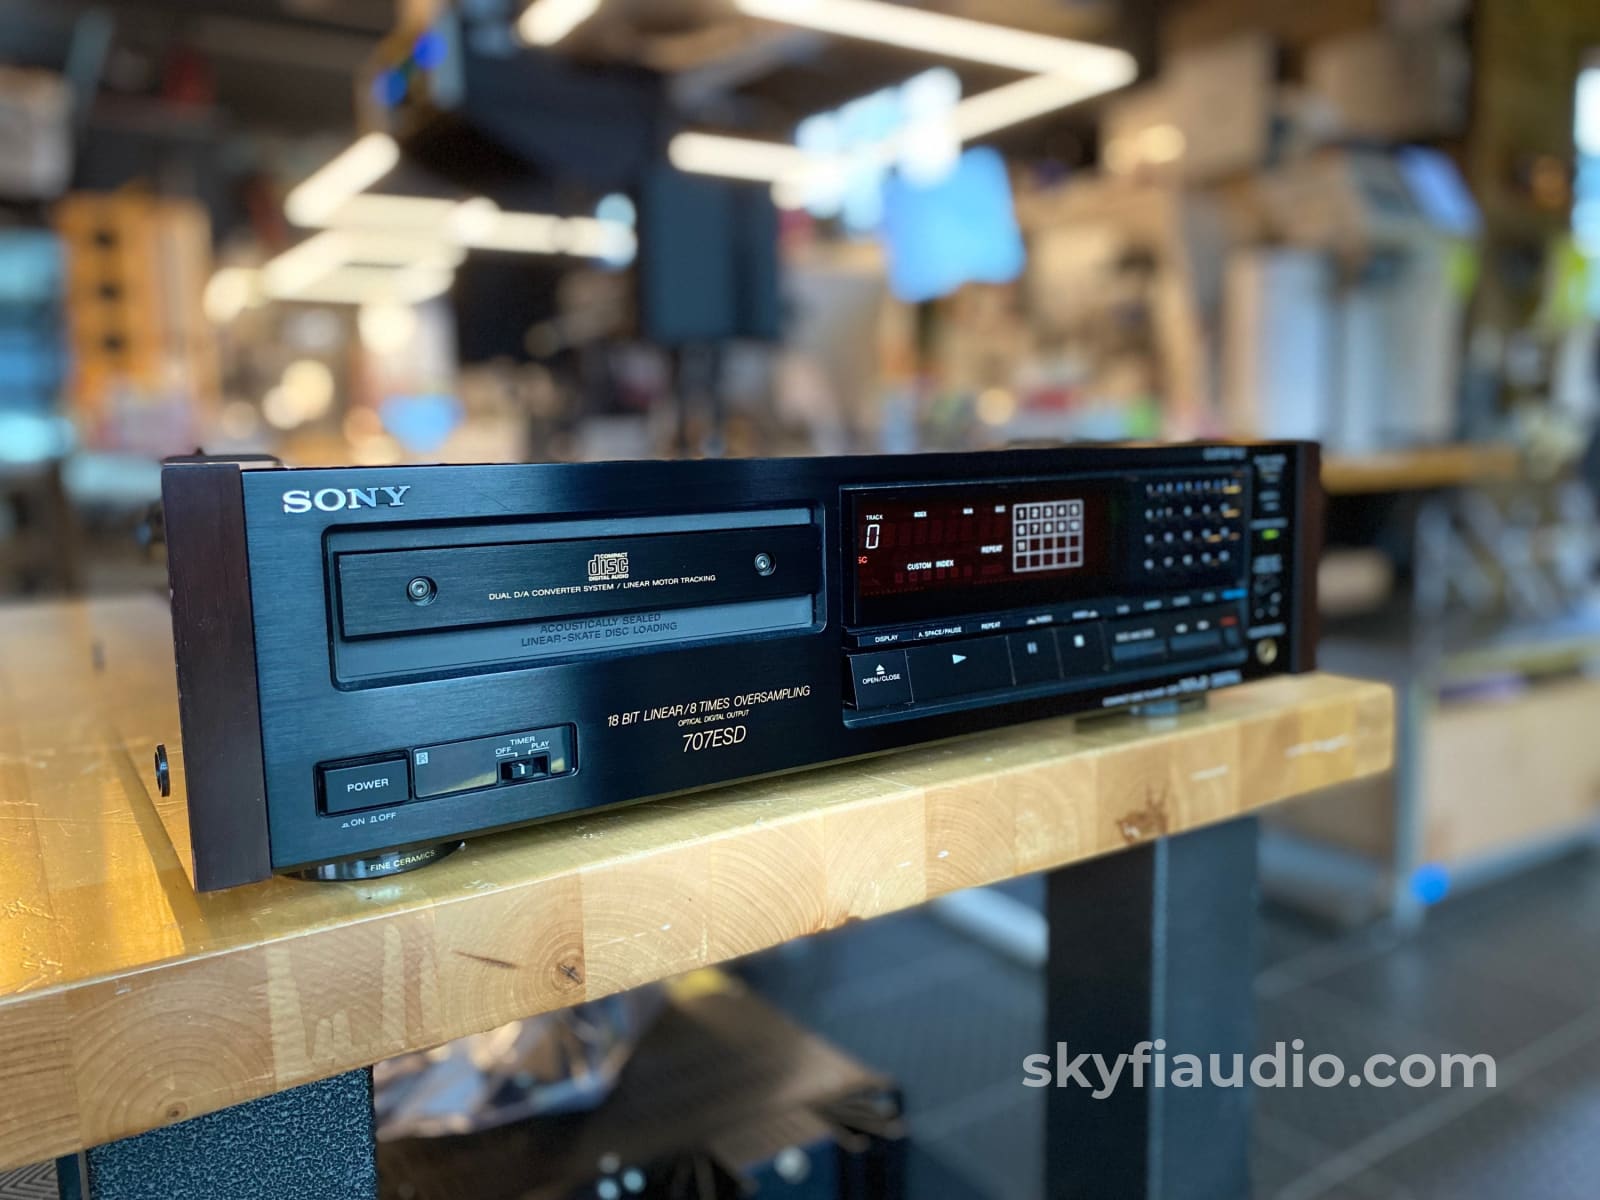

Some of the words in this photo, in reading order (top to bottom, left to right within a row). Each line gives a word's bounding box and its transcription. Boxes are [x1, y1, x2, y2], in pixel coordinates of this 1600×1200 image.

[282, 485, 411, 514] SONY
[981, 544, 1003, 554] REPEAT
[588, 554, 629, 576] disc
[907, 561, 932, 571] CUSTOM
[935, 559, 954, 568] INDEX
[488, 591, 512, 601] DUAL
[513, 589, 530, 598] D/A
[531, 586, 581, 598] CONVERTER
[583, 583, 614, 593] SYSTEM
[623, 580, 650, 589] LINEAR
[652, 577, 679, 586] MOTOR
[680, 574, 716, 584] TRACKING
[540, 617, 619, 634] ACOUSTICALLY
[622, 613, 661, 624] SEALED
[981, 621, 1001, 630] REPEAT
[521, 629, 601, 647] LINEAR-SKATE
[605, 626, 630, 638] DISC
[633, 622, 678, 635] LOADING
[874, 634, 899, 643] DISPLAY
[862, 673, 901, 685] OPEN/CLOSE
[607, 714, 619, 728] 18
[621, 710, 640, 726] BIT
[699, 697, 730, 713] TIMES
[734, 685, 811, 707] OVERSAMPLING
[678, 717, 702, 727] OPTICAL
[703, 713, 725, 723] DIGITAL
[726, 709, 750, 720] OUTPUT
[510, 736, 536, 746] TIMER
[531, 740, 550, 749] PLAY
[682, 725, 747, 753] 707ESD
[495, 746, 513, 755] OFF
[347, 777, 389, 793] POWER
[350, 816, 366, 827] ON
[378, 811, 397, 822] OFF
[370, 861, 391, 872] FINE
[393, 849, 436, 868] CERAMICS
